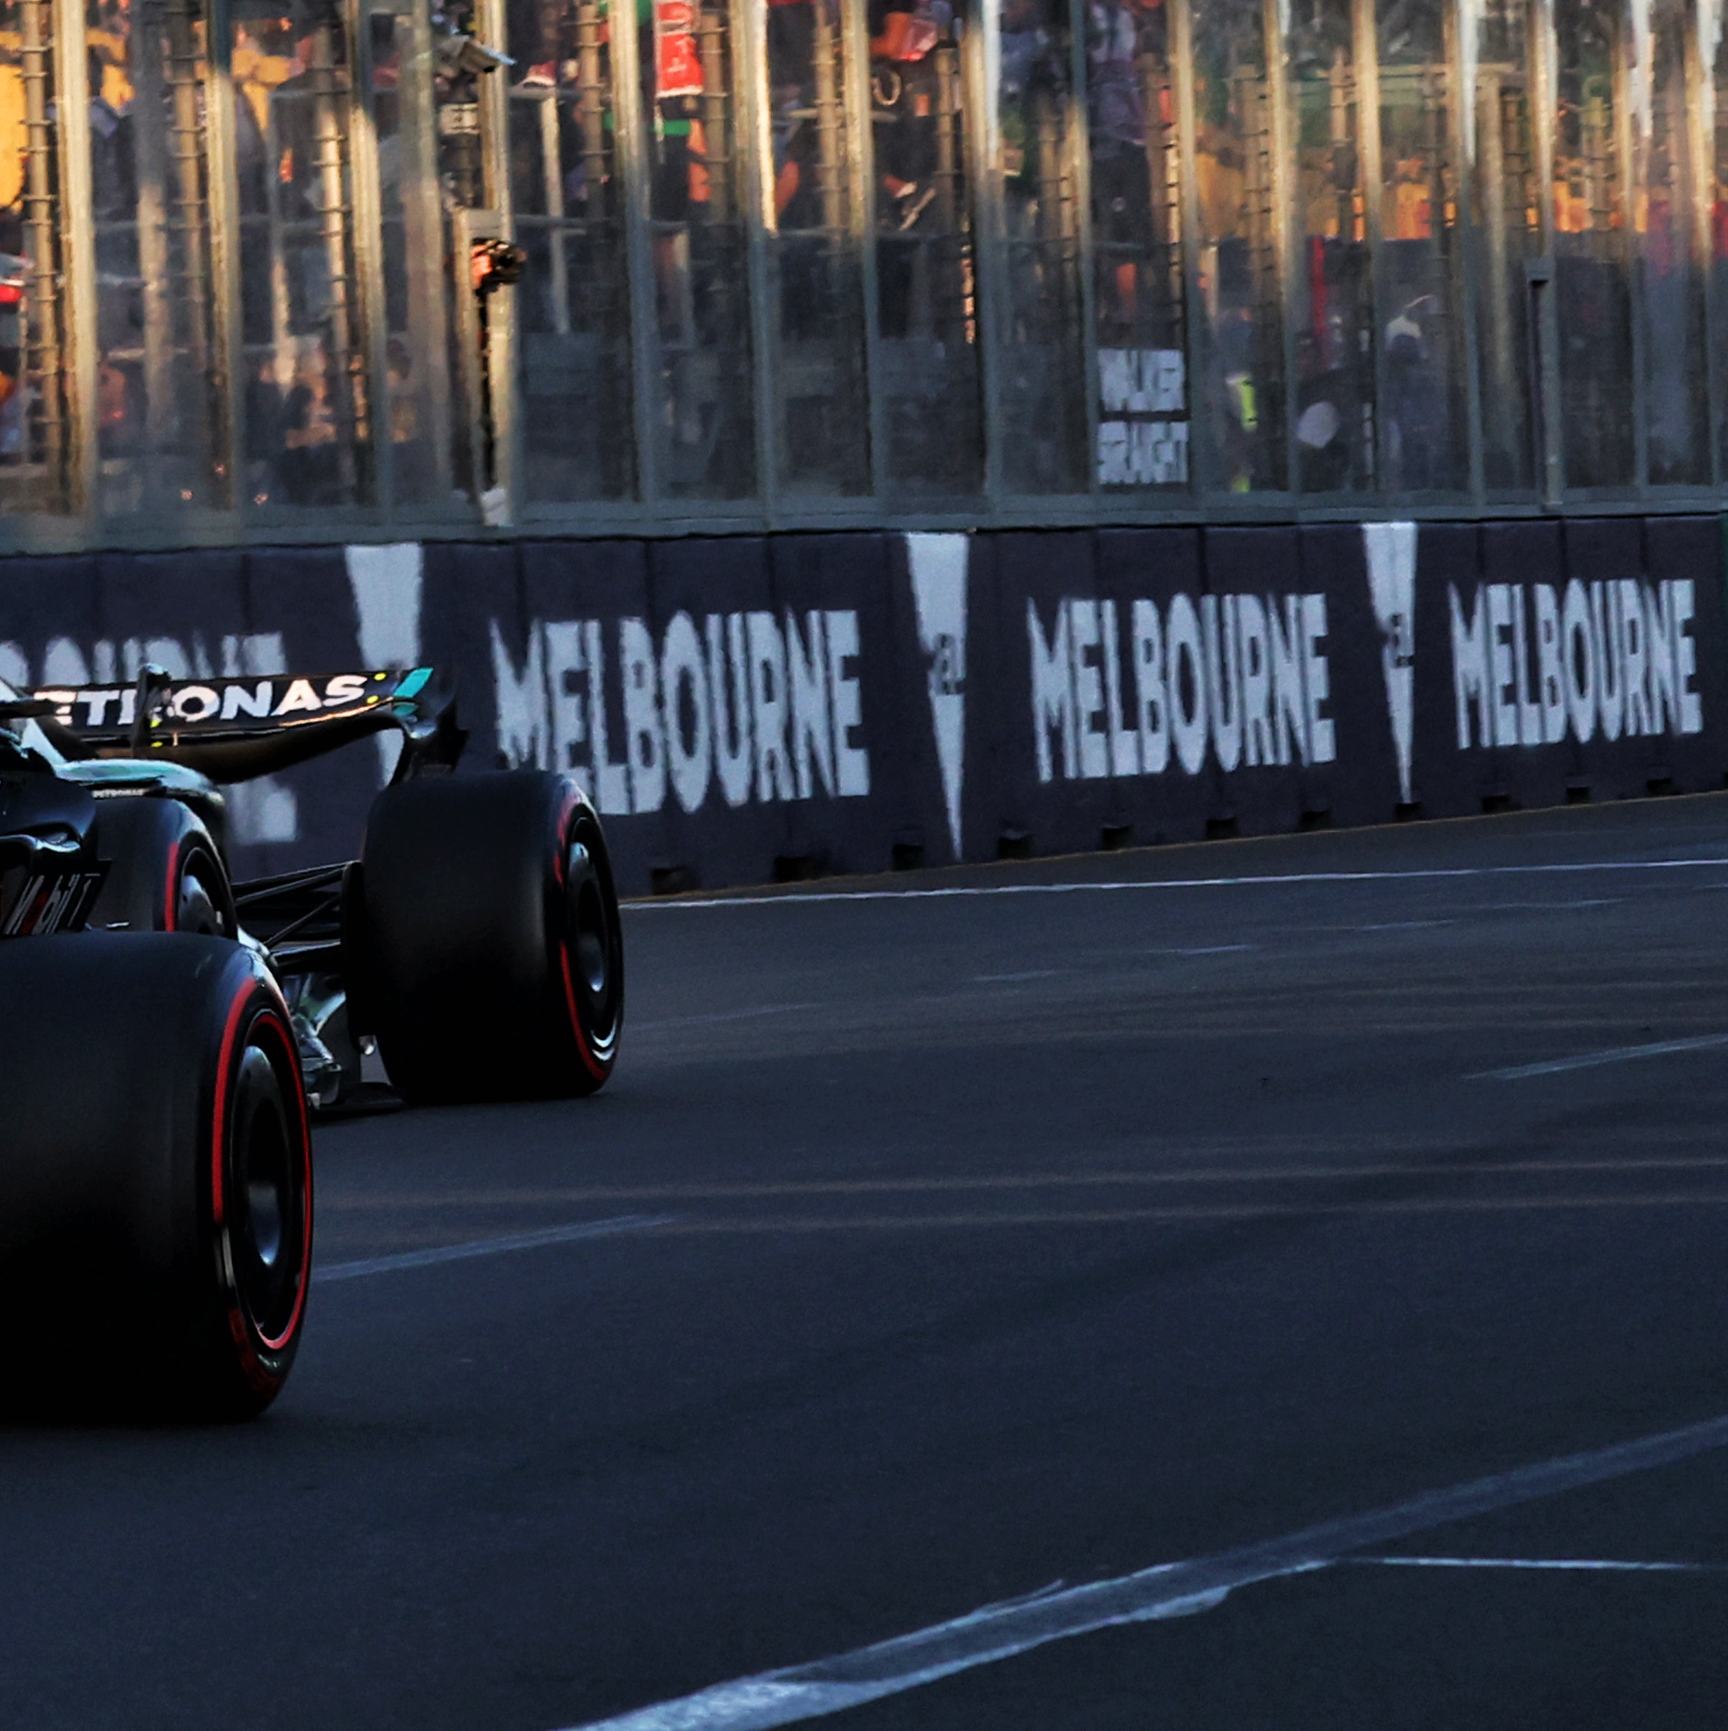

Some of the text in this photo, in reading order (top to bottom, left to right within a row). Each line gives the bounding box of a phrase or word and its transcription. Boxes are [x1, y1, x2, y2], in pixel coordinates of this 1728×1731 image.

[490, 604, 871, 816] MELBOURNE
[1027, 592, 1336, 784] MELBOURNE
[1448, 578, 1703, 750] MELBOURNE
